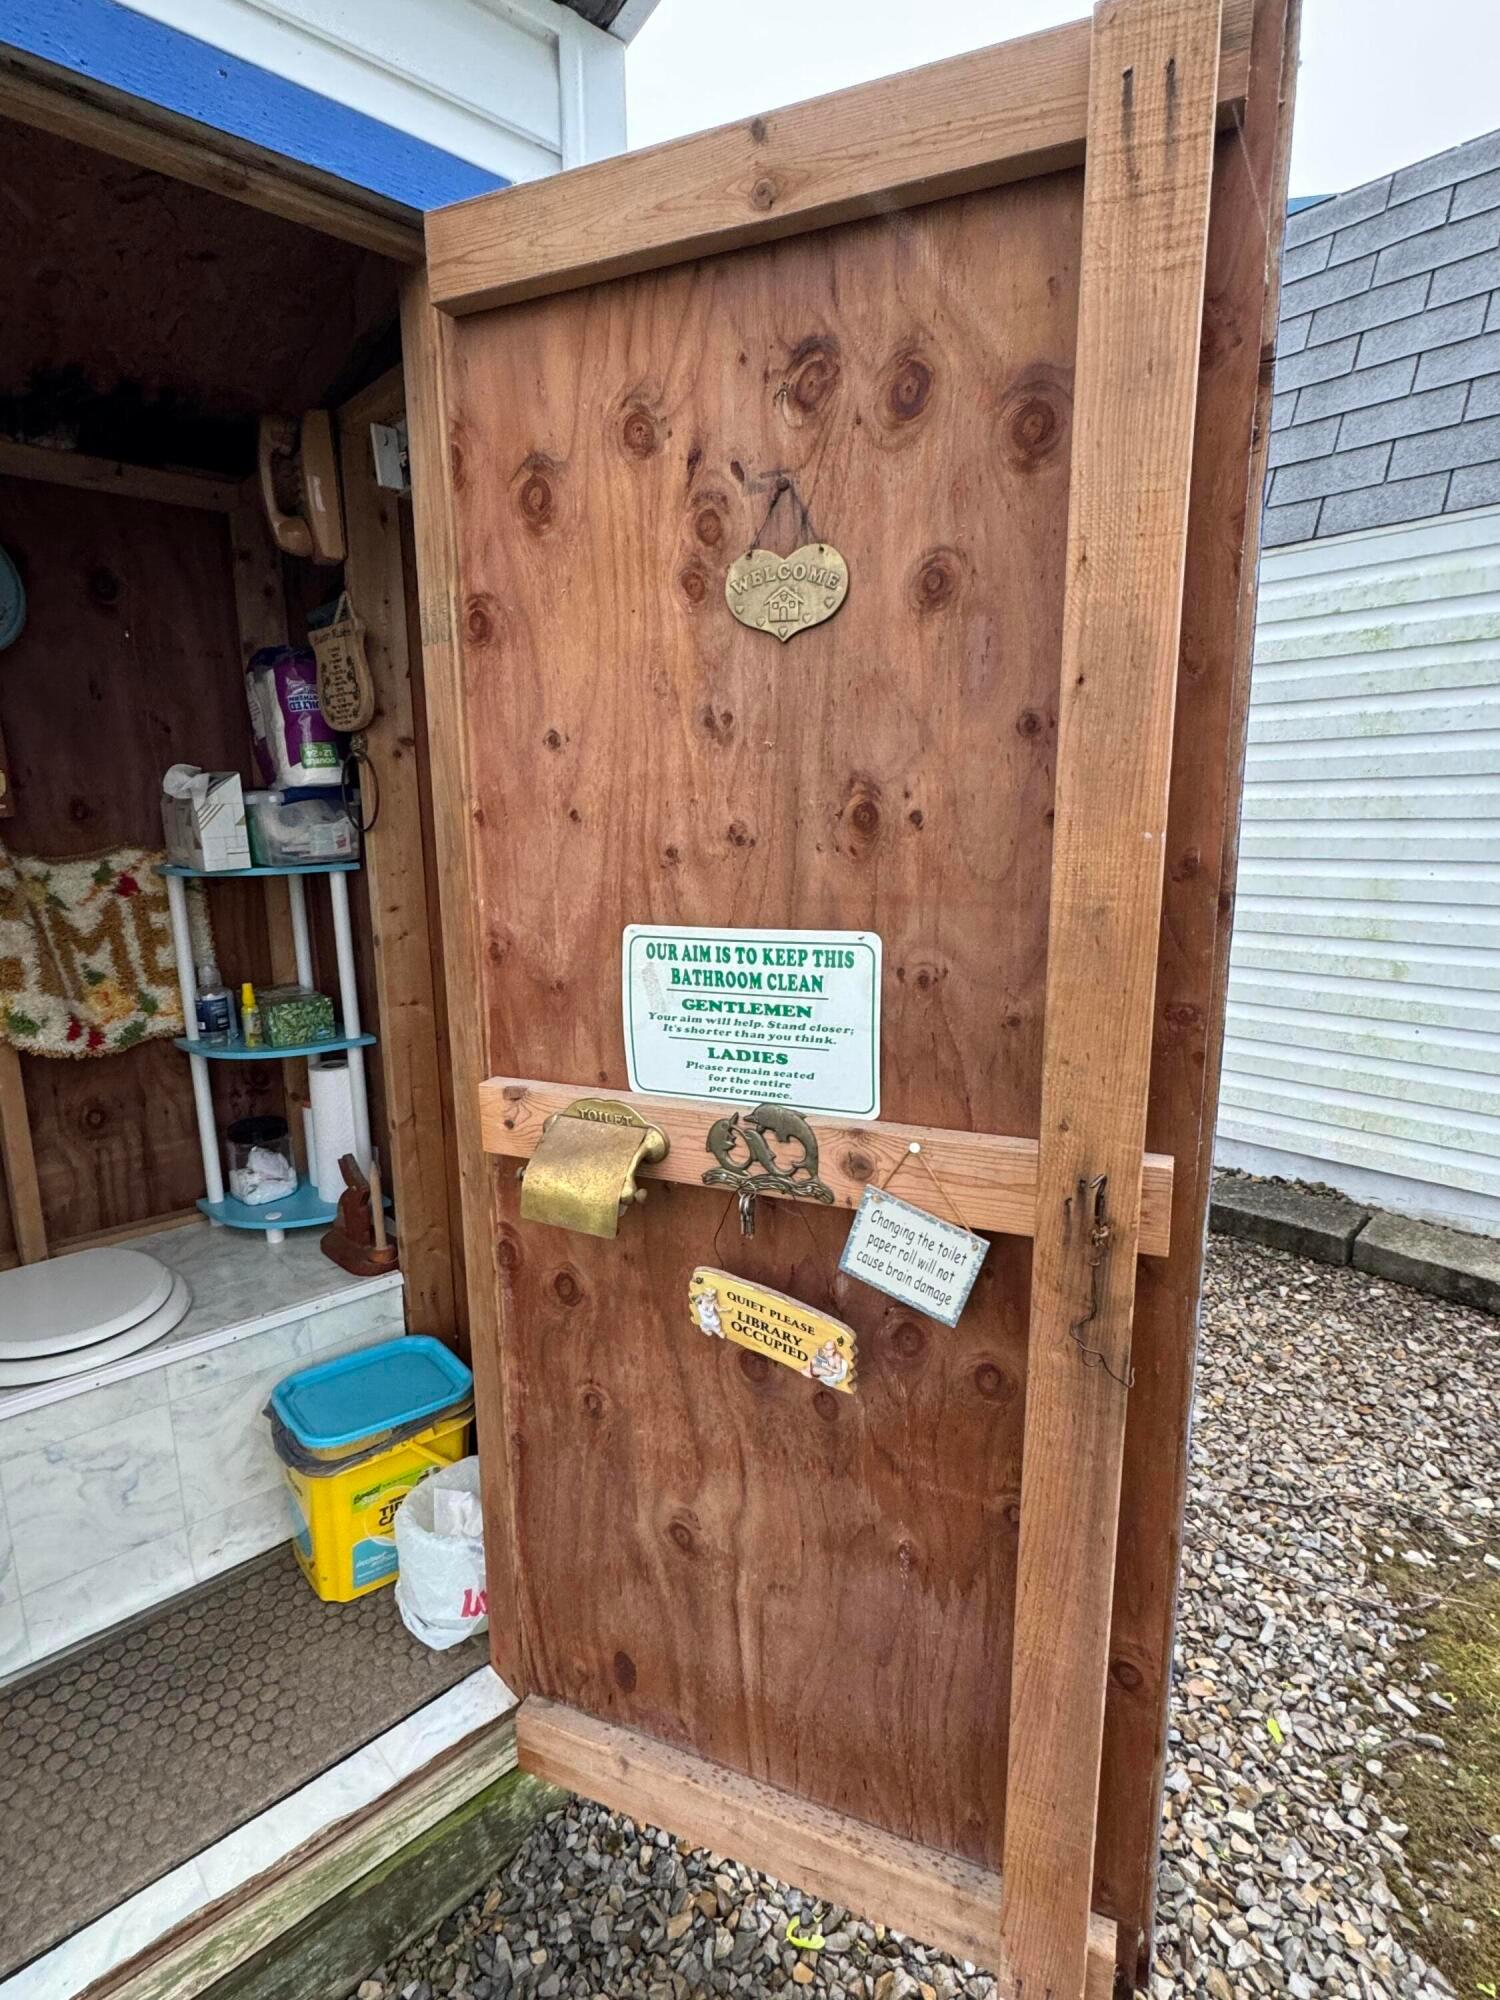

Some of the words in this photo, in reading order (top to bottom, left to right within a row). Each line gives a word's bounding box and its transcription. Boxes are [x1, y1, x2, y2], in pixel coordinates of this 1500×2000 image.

[730, 564, 840, 595] WELCOME
[646, 942, 678, 960] OUR
[681, 944, 711, 963] AIM
[715, 946, 731, 964] IS
[735, 947, 757, 965] TO
[762, 948, 808, 967] KEEP
[812, 949, 855, 969] THIS
[671, 967, 762, 989] BATHROOM
[767, 973, 824, 992] CLEAN
[681, 998, 812, 1018] GENTLEMEN
[648, 1011, 678, 1022] Your
[680, 1015, 702, 1024] aim
[705, 1017, 731, 1026] will
[733, 1019, 765, 1029] help.
[767, 1020, 807, 1031] Stand
[663, 1023, 682, 1033] It's
[684, 1026, 732, 1037] shorter
[734, 1030, 765, 1039] than
[767, 1033, 792, 1041] you
[795, 1034, 837, 1045] think.
[707, 1047, 789, 1065] LADIES
[685, 1060, 724, 1072] Please
[726, 1066, 771, 1077] remain
[773, 1070, 815, 1080] seated
[708, 1073, 727, 1083] for
[730, 1076, 751, 1085] the
[753, 1080, 792, 1089] entire
[709, 1085, 793, 1100] performance.
[577, 1107, 633, 1126] TOILET
[871, 1209, 915, 1245] Changing
[918, 1232, 935, 1251] the
[938, 1242, 967, 1266] toilet
[866, 1233, 896, 1254] paper
[898, 1248, 918, 1265] roll
[917, 1258, 937, 1275] will
[937, 1267, 955, 1283] not
[856, 1251, 887, 1272] cause
[885, 1261, 912, 1286] brain
[913, 1278, 952, 1306] damage
[726, 1291, 767, 1313] QUIET
[769, 1307, 815, 1336] PLEASE
[737, 1311, 804, 1347] LIBRARY
[731, 1321, 809, 1363] OCCUPIED
